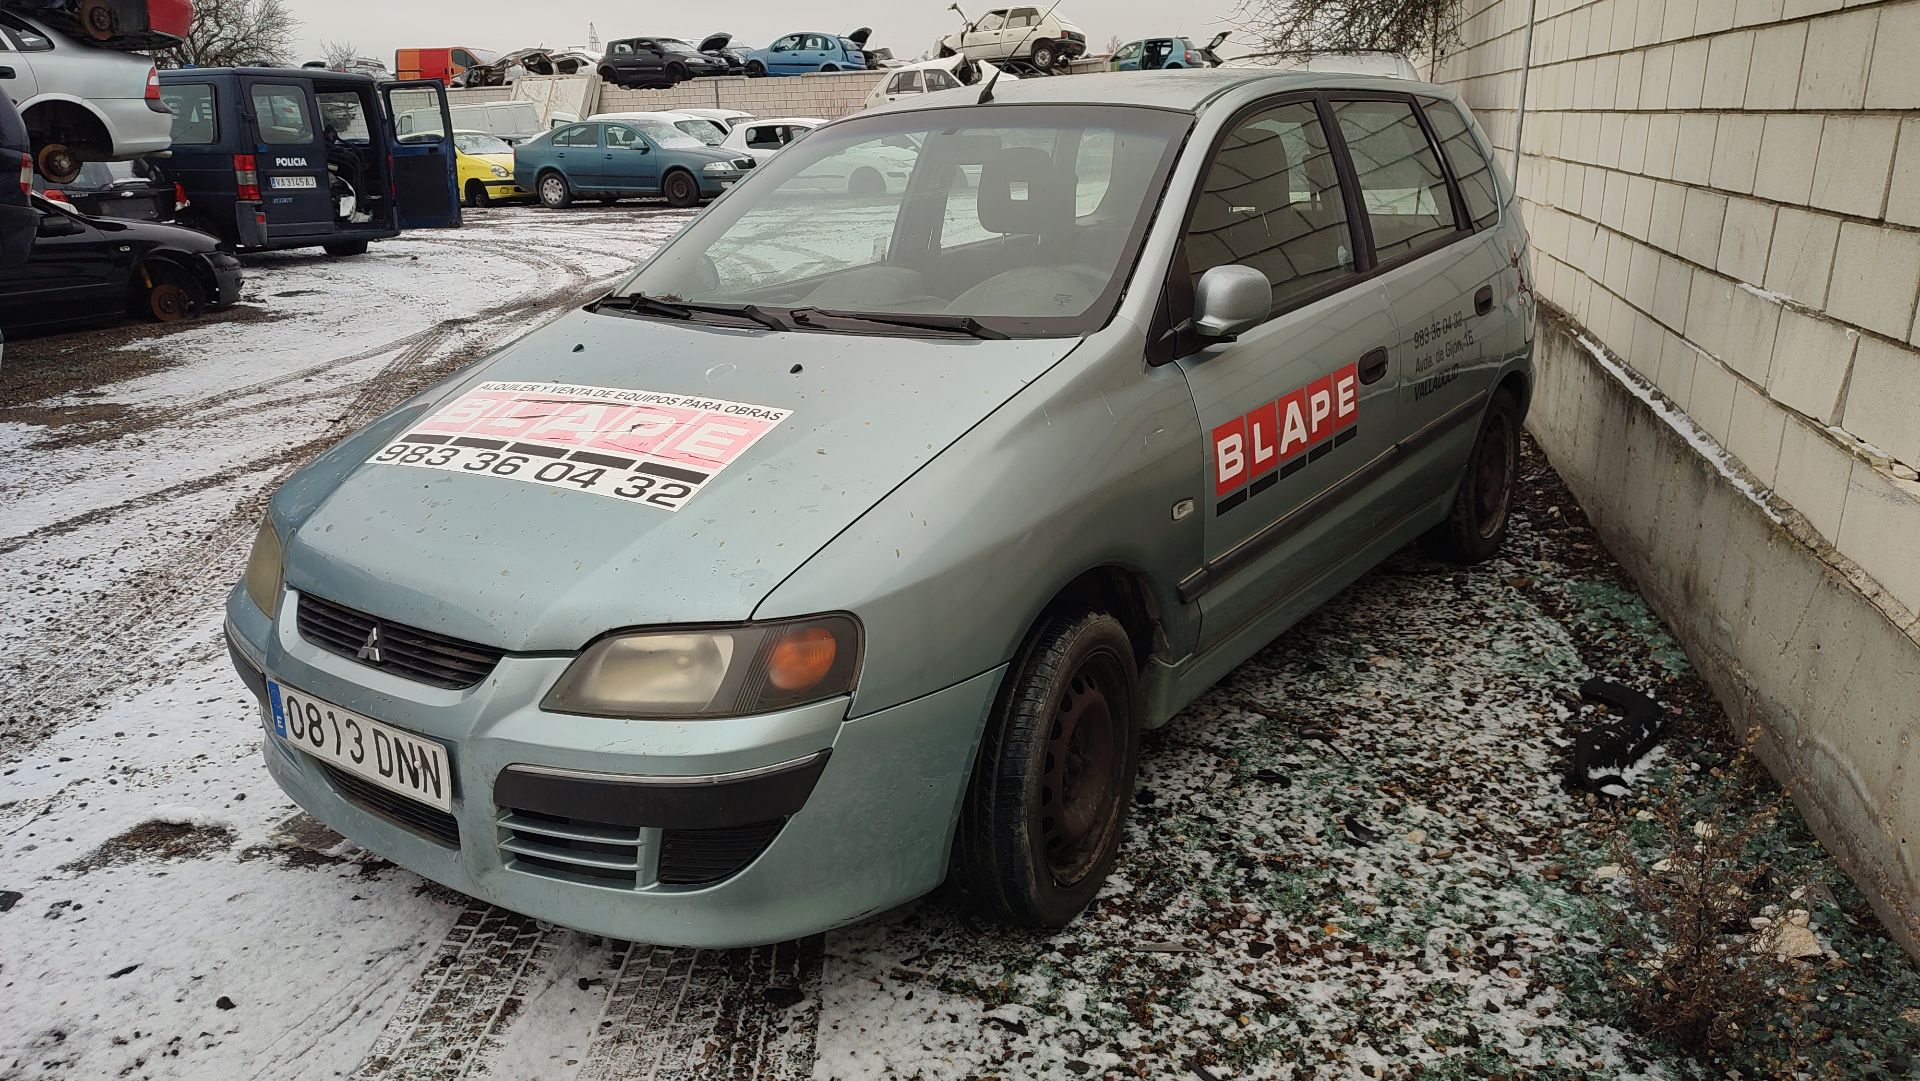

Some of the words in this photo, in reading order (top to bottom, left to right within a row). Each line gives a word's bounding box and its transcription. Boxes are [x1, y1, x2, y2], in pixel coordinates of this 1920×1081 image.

[275, 157, 307, 166] POLICIA
[1414, 327, 1429, 349] 983
[1431, 322, 1441, 340] 36
[1442, 315, 1452, 334] 04
[1453, 311, 1462, 328] 32
[1435, 347, 1444, 363] de
[1414, 363, 1459, 402] VALLADOLID
[480, 383, 539, 392] ALQUILER
[539, 385, 549, 393] Y
[550, 385, 593, 397] VENTA
[592, 389, 613, 399] DE
[614, 391, 681, 406] EQUIPOS
[678, 399, 723, 412] PARA
[724, 405, 784, 422] OBRAS
[432, 399, 749, 459] BLAPE
[1217, 374, 1355, 484] BLAPE
[375, 444, 461, 466] 983
[462, 452, 530, 476] 36
[533, 462, 608, 489] 04
[613, 475, 692, 508] 32
[286, 695, 365, 765] 0813
[372, 727, 442, 800] DNN
